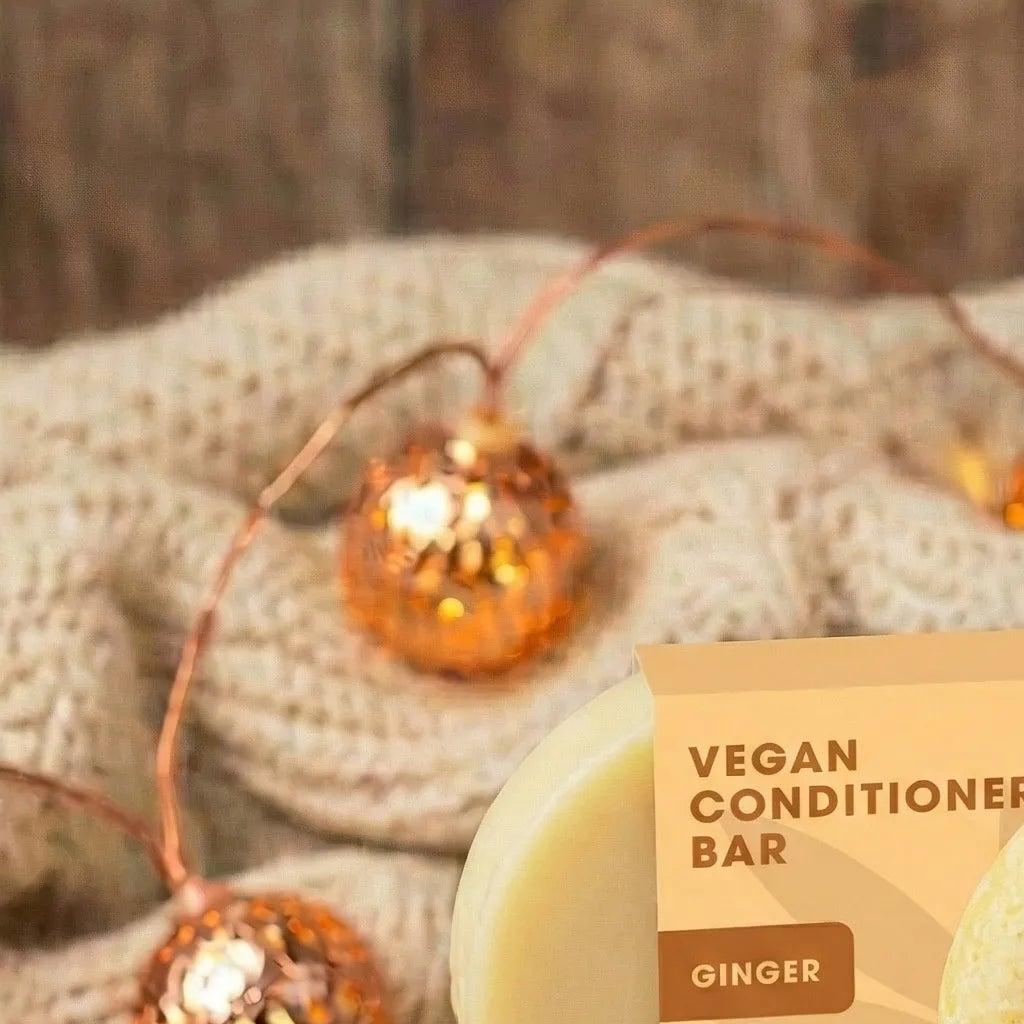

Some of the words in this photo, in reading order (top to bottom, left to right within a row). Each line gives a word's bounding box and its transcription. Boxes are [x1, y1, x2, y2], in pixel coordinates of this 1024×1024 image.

[687, 738, 857, 778] VEGAN
[692, 832, 787, 869] BAR
[691, 958, 820, 988] GINGER
